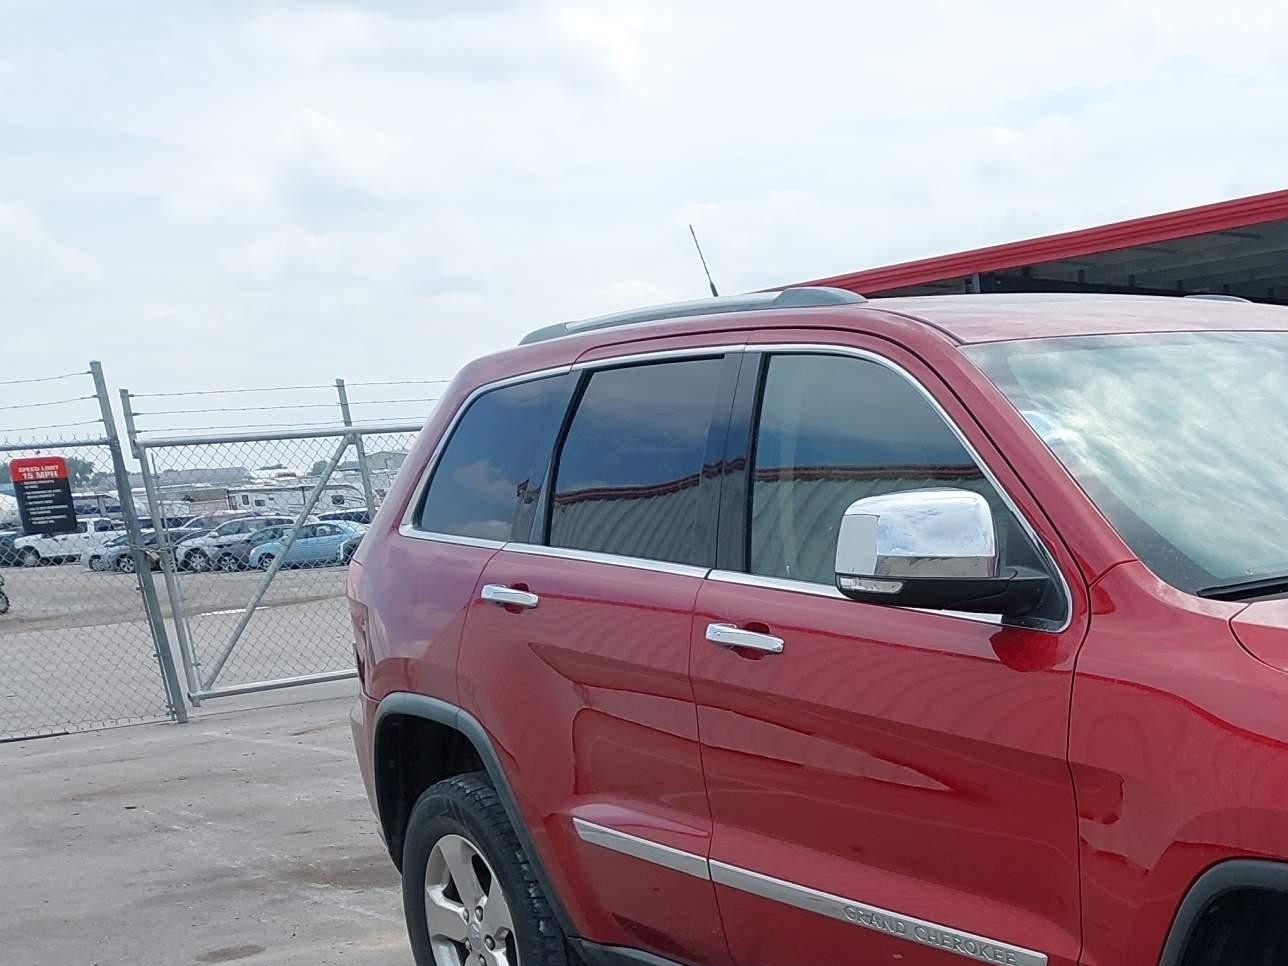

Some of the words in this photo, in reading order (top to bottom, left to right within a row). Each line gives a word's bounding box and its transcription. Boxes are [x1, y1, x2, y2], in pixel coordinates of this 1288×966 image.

[22, 472, 34, 480] 15
[36, 470, 58, 479] MPH
[843, 905, 906, 937] GRAND
[914, 925, 1017, 966] CHEROKEE
